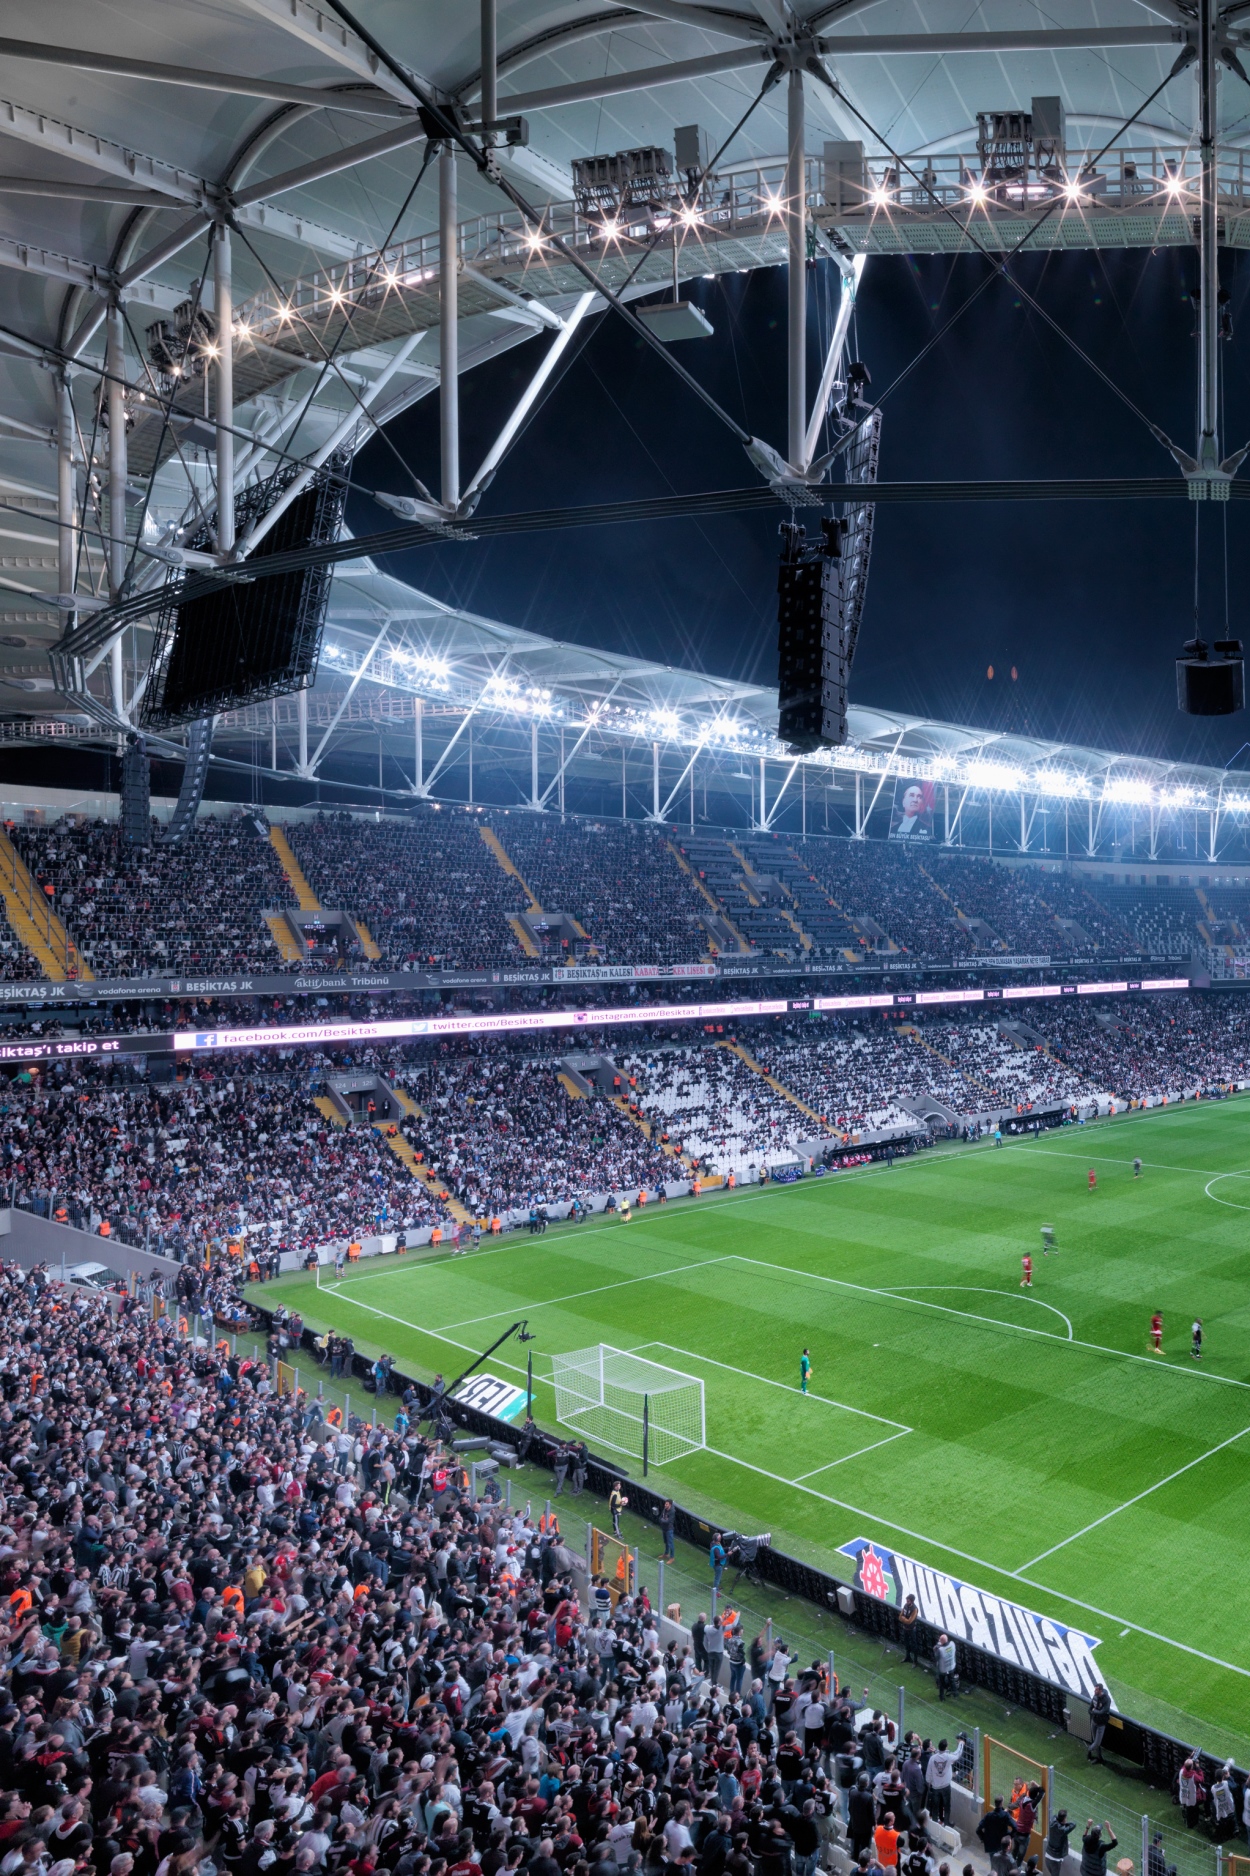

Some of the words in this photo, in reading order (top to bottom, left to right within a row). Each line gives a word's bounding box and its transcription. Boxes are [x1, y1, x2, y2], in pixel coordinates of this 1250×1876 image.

[503, 972, 539, 982] BEŞİKTAŞ
[540, 972, 550, 981] JK
[724, 966, 750, 976] BEŞİKTAŞ
[186, 979, 237, 993] BEŞİKTAŞ
[240, 981, 253, 990] JK
[351, 976, 390, 986] Tribünü
[50, 986, 66, 996] JK
[591, 1008, 696, 1021] instagram.com/Besiktas
[433, 1017, 545, 1030] twitter.com/Besiktas
[224, 1026, 378, 1043] facebook.com/Besiktas
[56, 1042, 97, 1054] takip
[102, 1040, 120, 1050] et
